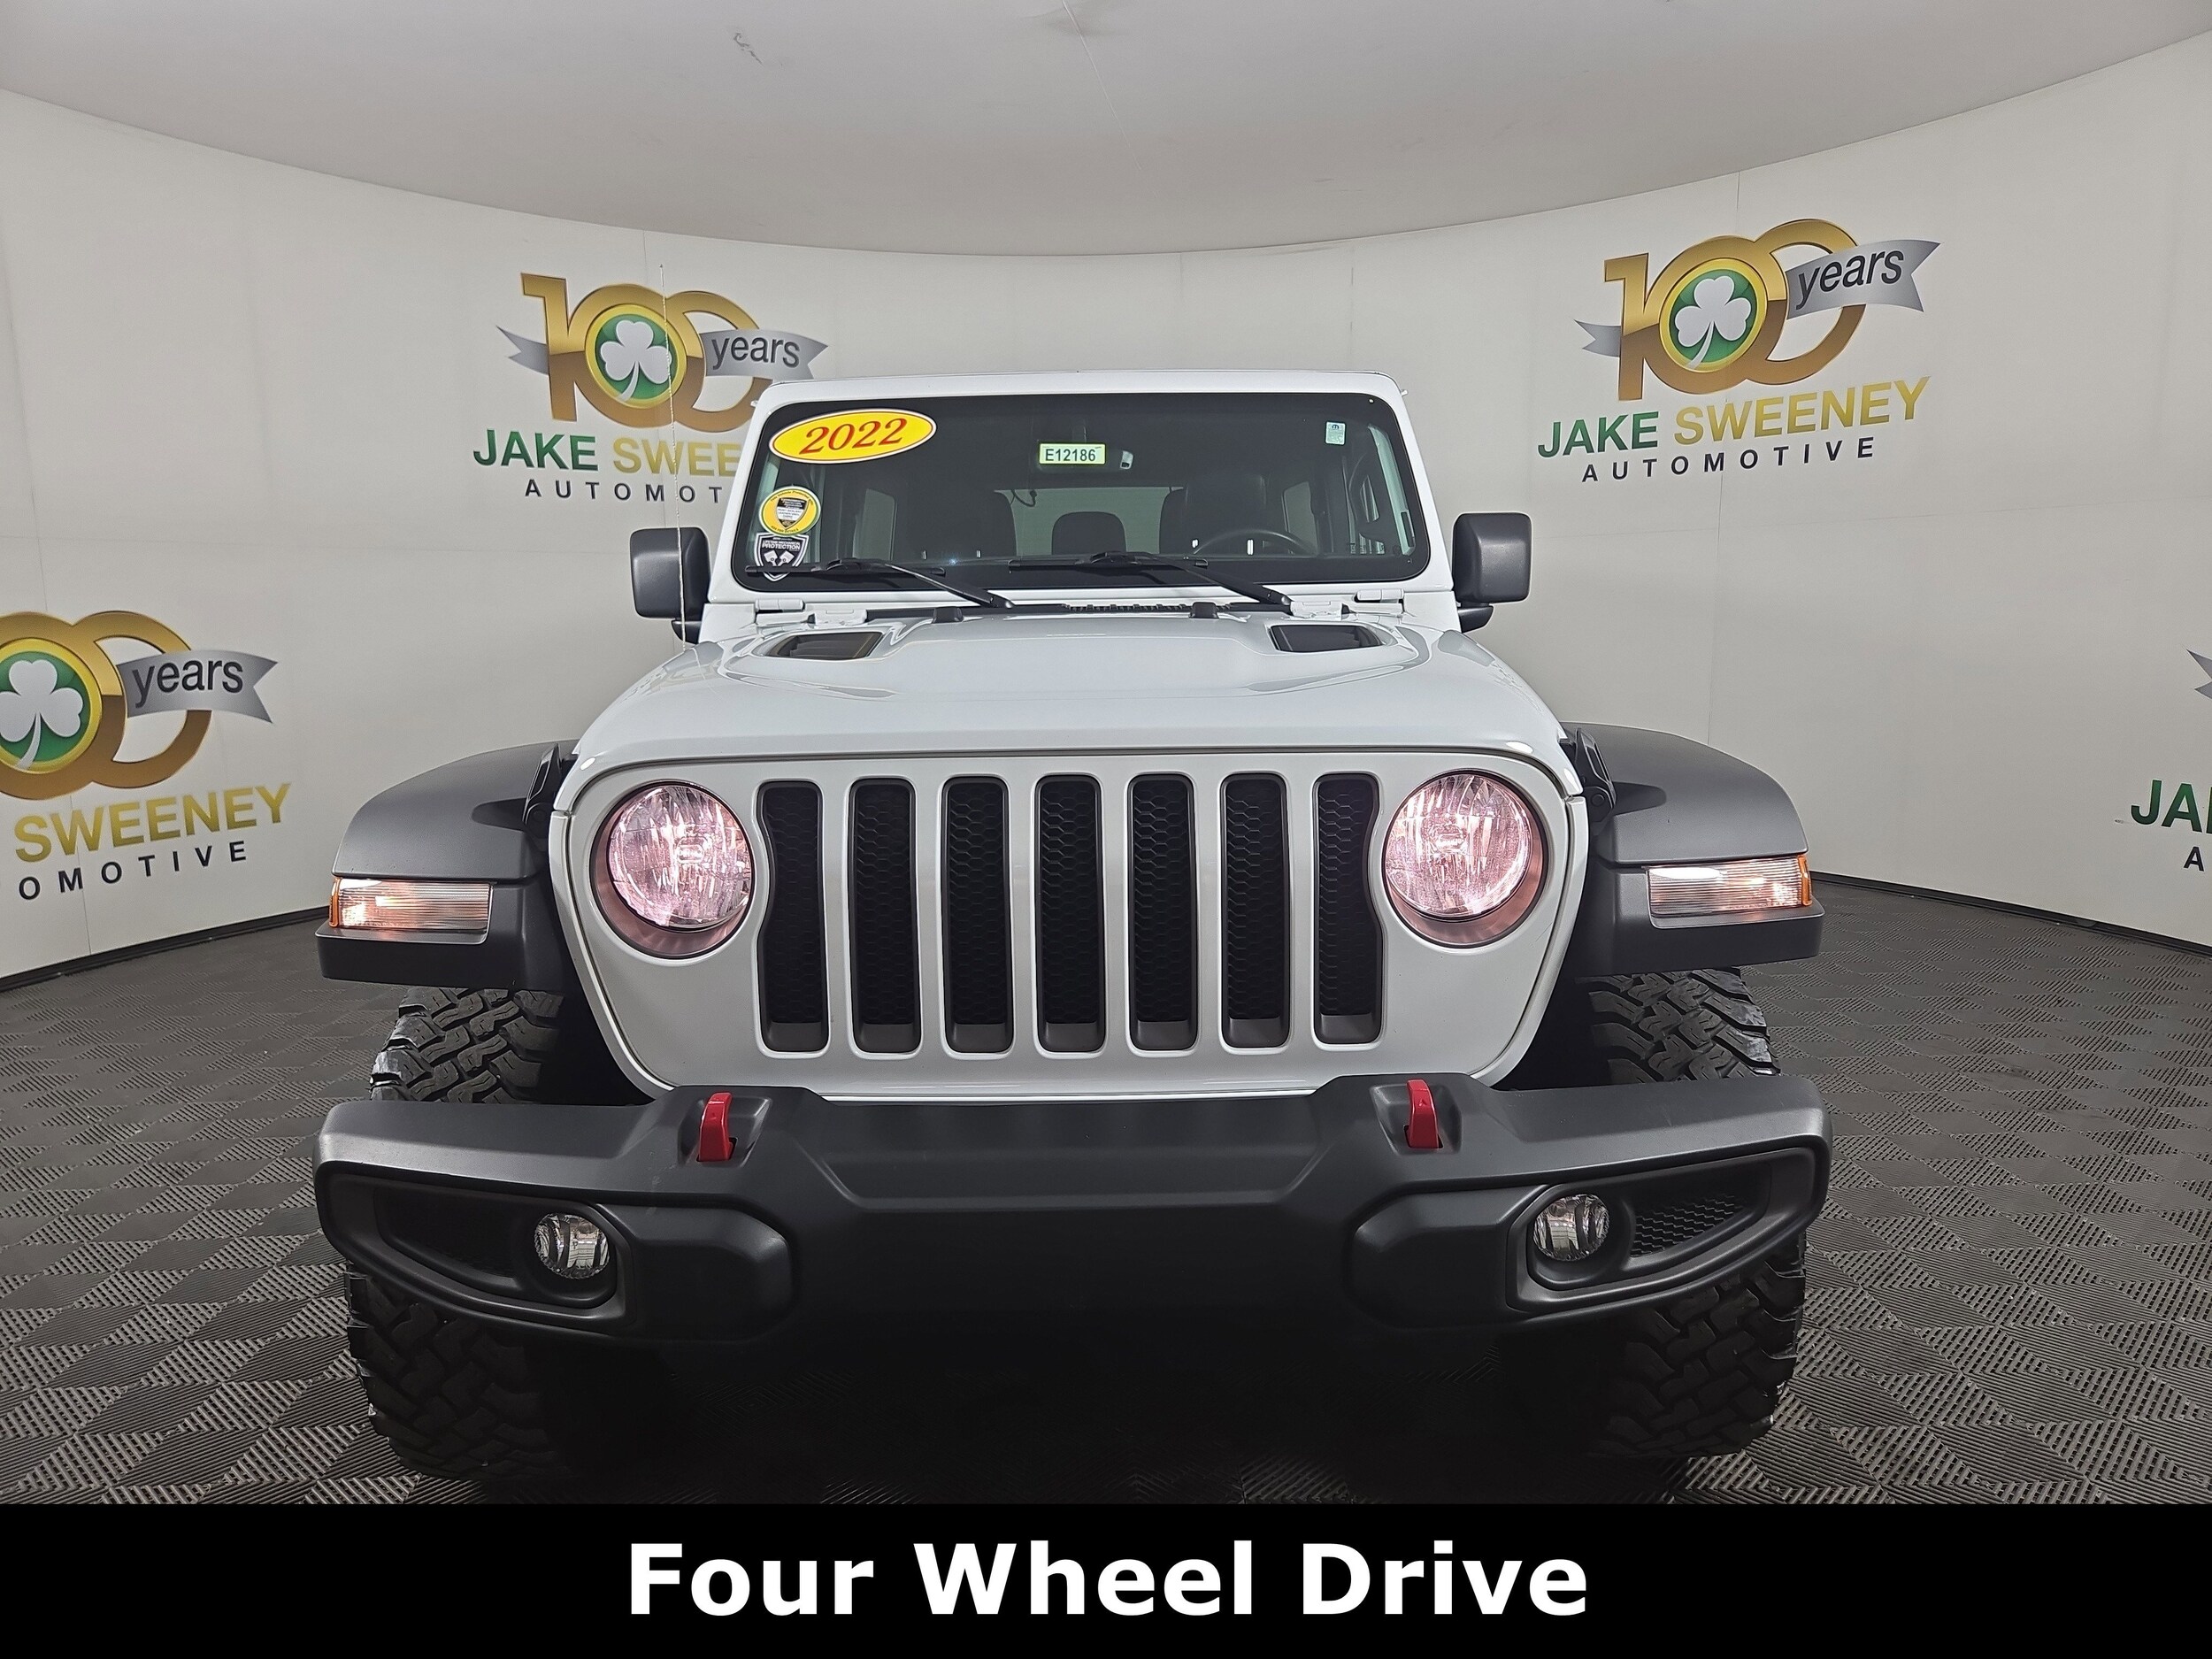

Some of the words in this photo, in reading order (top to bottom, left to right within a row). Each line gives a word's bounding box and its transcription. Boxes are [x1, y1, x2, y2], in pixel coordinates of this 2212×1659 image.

[1604, 219, 1866, 401] 100
[1795, 250, 1904, 311] years
[521, 273, 760, 433] 100
[711, 334, 801, 371] years
[799, 419, 908, 455] 2022
[1538, 411, 1659, 458] JAKE
[1674, 376, 1931, 446] SWEENEY
[473, 428, 599, 471] JAKE
[613, 437, 743, 477] SWEE
[1045, 449, 1096, 462] E12186
[1582, 436, 1875, 482] AUTOMOTIVE
[526, 479, 723, 503] AUTOMOT
[132, 660, 244, 708] years
[14, 783, 292, 864] SWEENEY
[2131, 779, 2212, 834] JA
[19, 841, 247, 901] OMOTIVE
[2184, 846, 2205, 872] A
